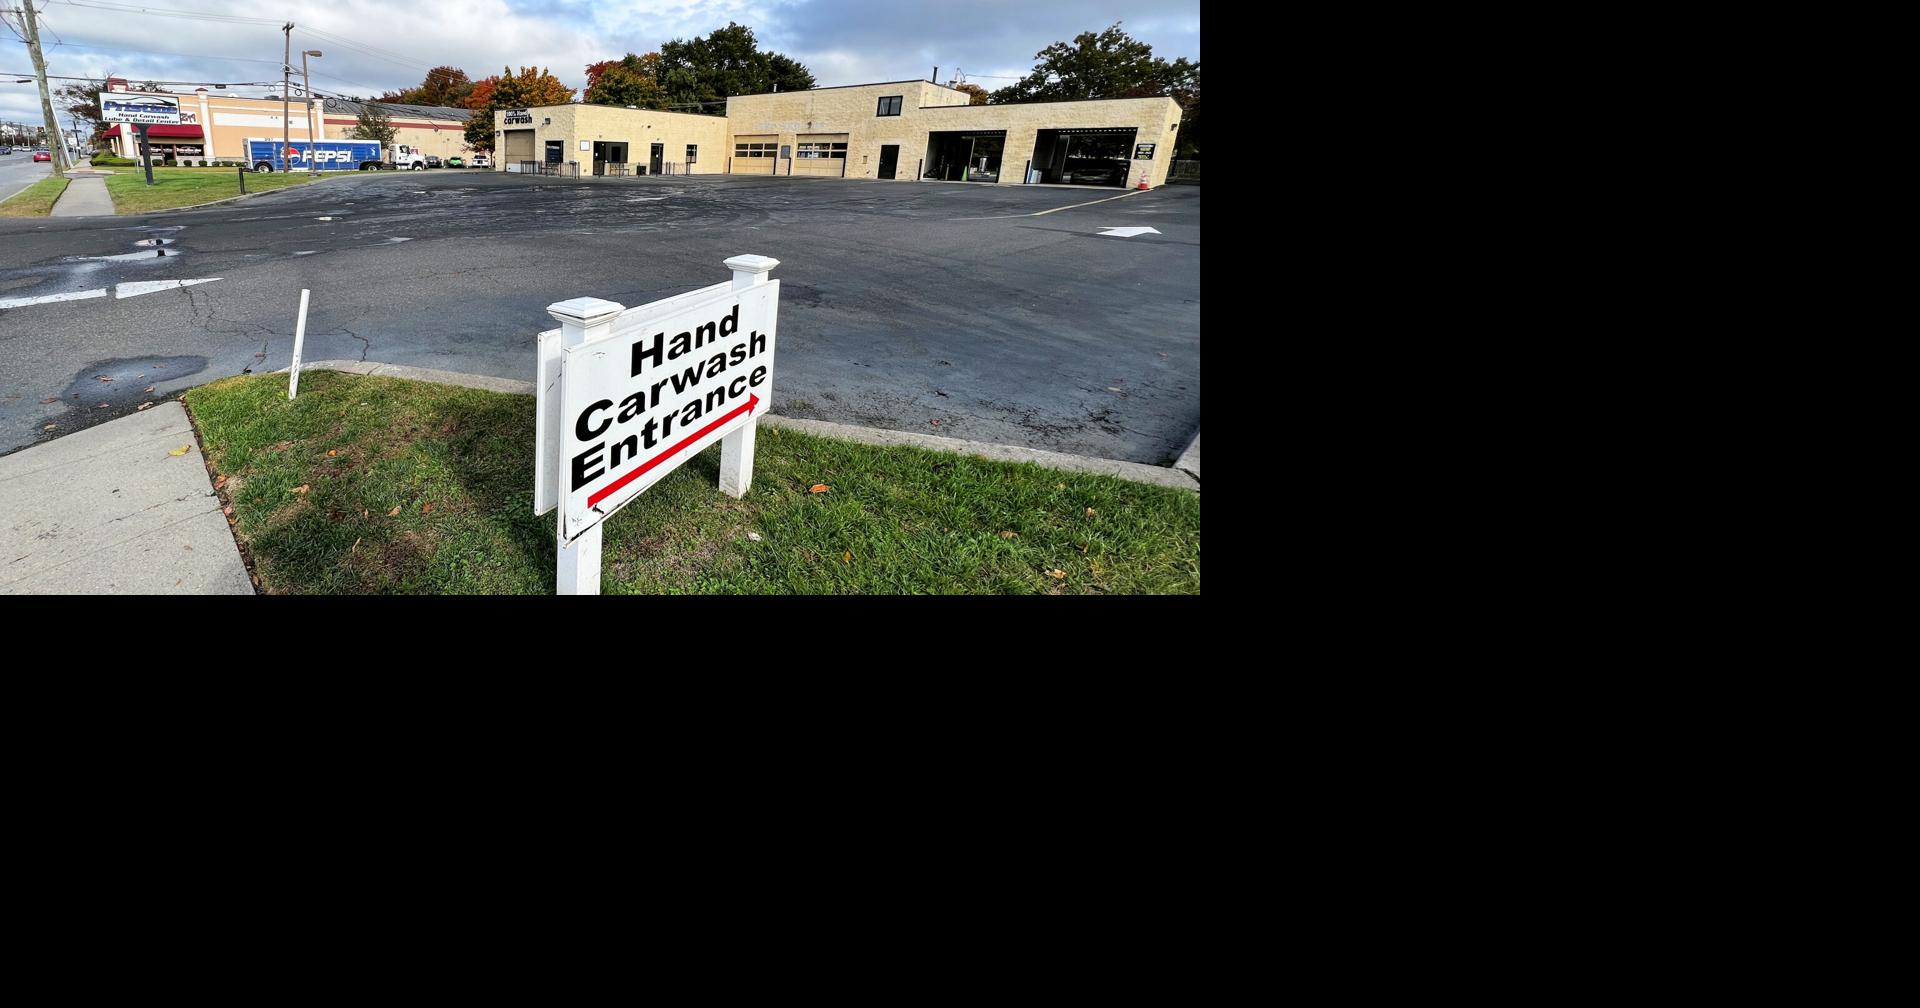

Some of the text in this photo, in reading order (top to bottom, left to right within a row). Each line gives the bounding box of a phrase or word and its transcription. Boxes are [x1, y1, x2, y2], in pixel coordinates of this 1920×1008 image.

[302, 150, 352, 162] PEPSI
[575, 330, 766, 442] Carwash
[631, 304, 739, 377] Hand
[571, 365, 767, 492] Entrance
